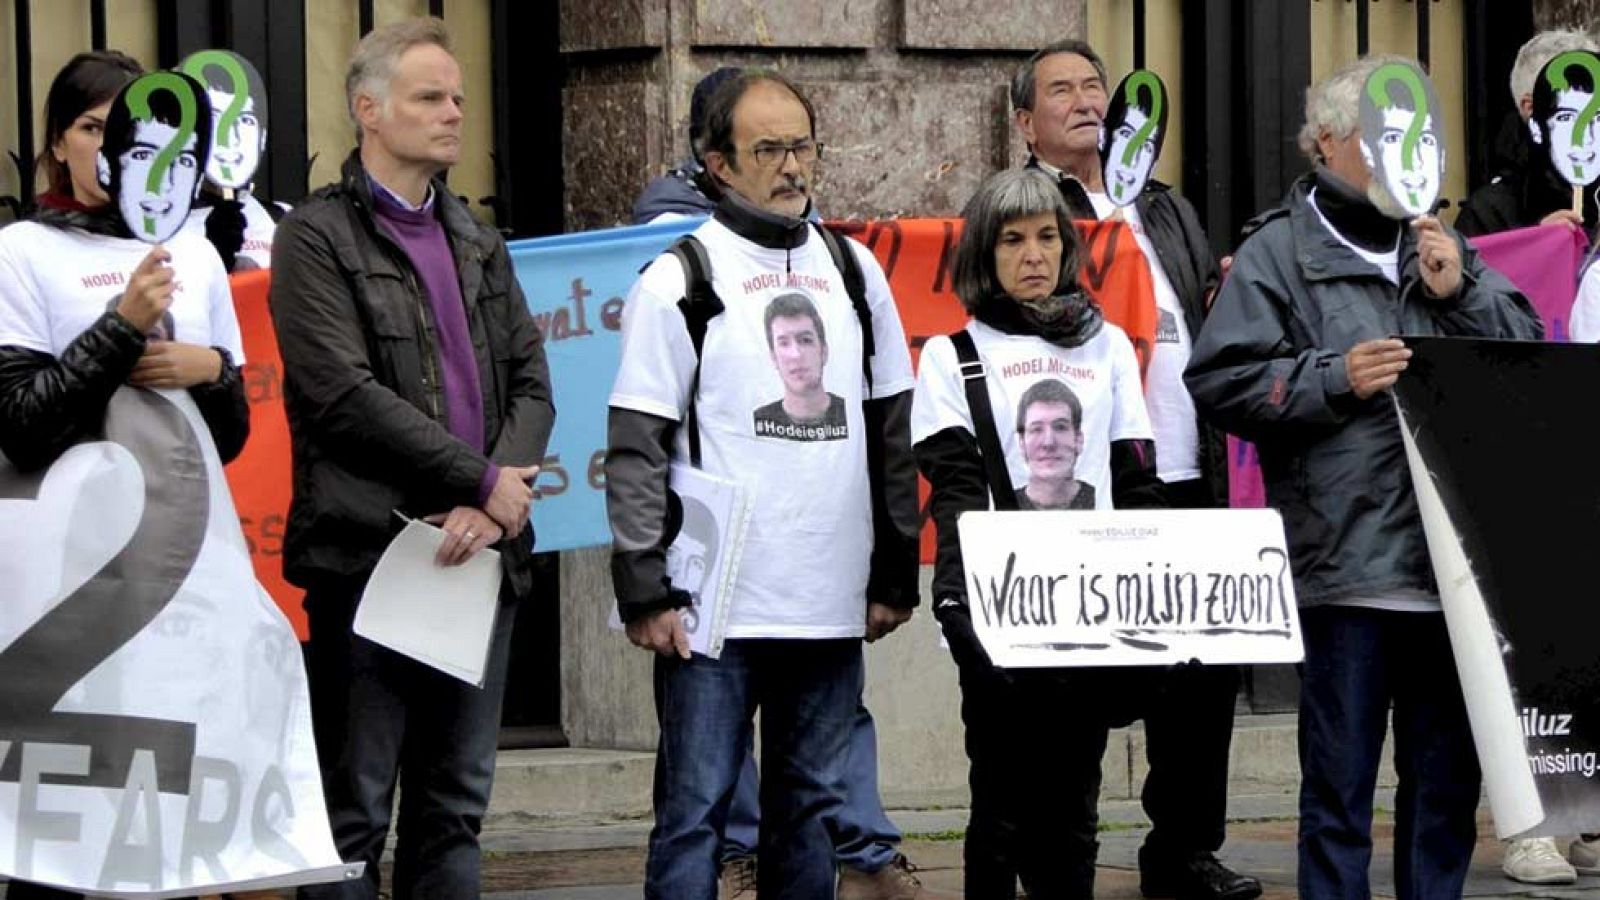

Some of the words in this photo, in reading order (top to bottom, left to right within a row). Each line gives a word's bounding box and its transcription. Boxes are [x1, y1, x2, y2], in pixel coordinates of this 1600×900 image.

[80, 271, 125, 288] HODEI
[742, 273, 781, 294] HODEI
[1002, 357, 1042, 379] HODEI
[756, 420, 848, 439] #Hodeiegiluz
[971, 551, 1068, 628] Waar
[1076, 563, 1109, 626] is
[1116, 562, 1198, 627] mijn
[1205, 547, 1291, 629] zoon?
